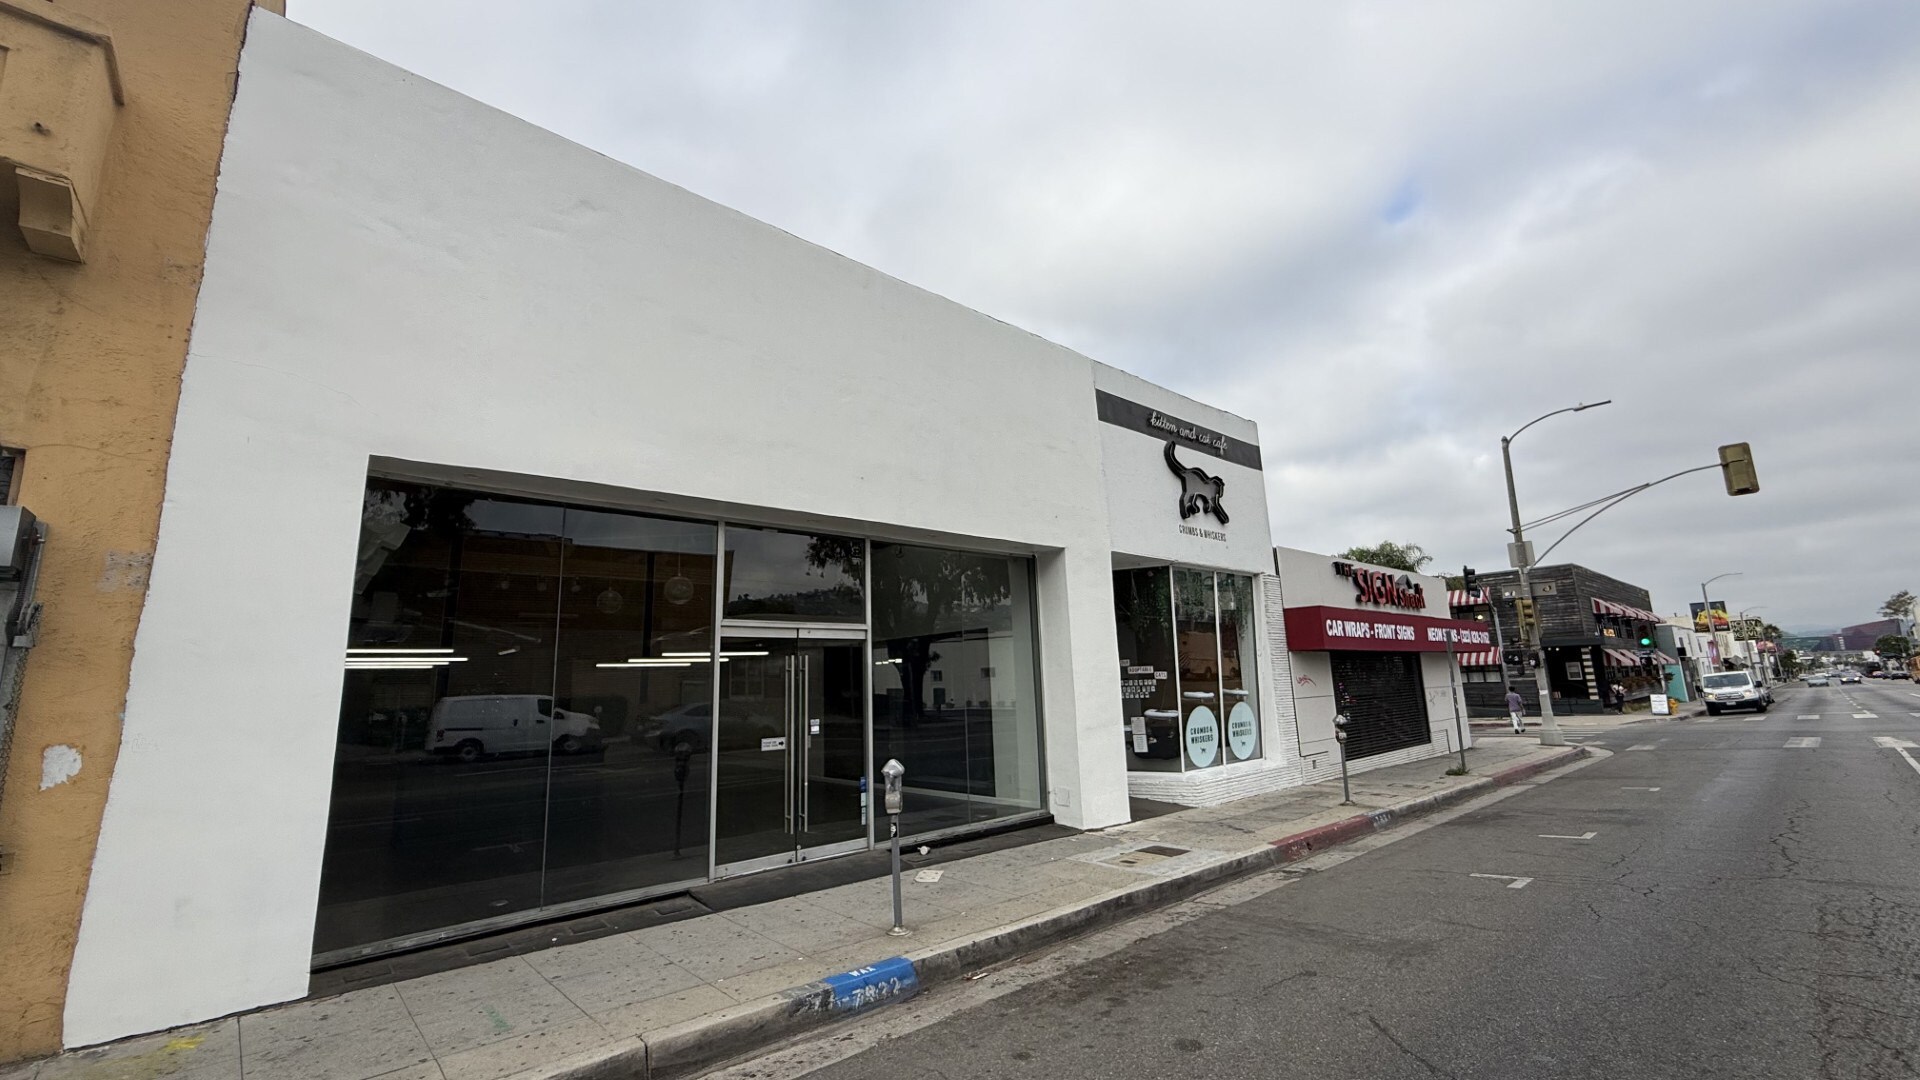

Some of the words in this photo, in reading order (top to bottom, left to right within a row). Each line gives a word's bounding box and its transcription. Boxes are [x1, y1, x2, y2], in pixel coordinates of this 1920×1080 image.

[1151, 411, 1177, 433] kitten
[1180, 427, 1196, 439] and
[1199, 434, 1210, 445] cat
[1179, 524, 1198, 537] CRUMBS
[1204, 530, 1226, 542] WHISKERS
[1332, 561, 1354, 578] THE
[1354, 568, 1398, 606] SIGN
[1326, 619, 1344, 637] CAR
[1344, 621, 1370, 639] WRAPS
[1374, 623, 1396, 640] FRONT
[1397, 625, 1415, 640] SIGNS
[1427, 627, 1443, 641] NEON
[1442, 628, 1458, 643] SNS
[1191, 734, 1213, 744] WHISKERS
